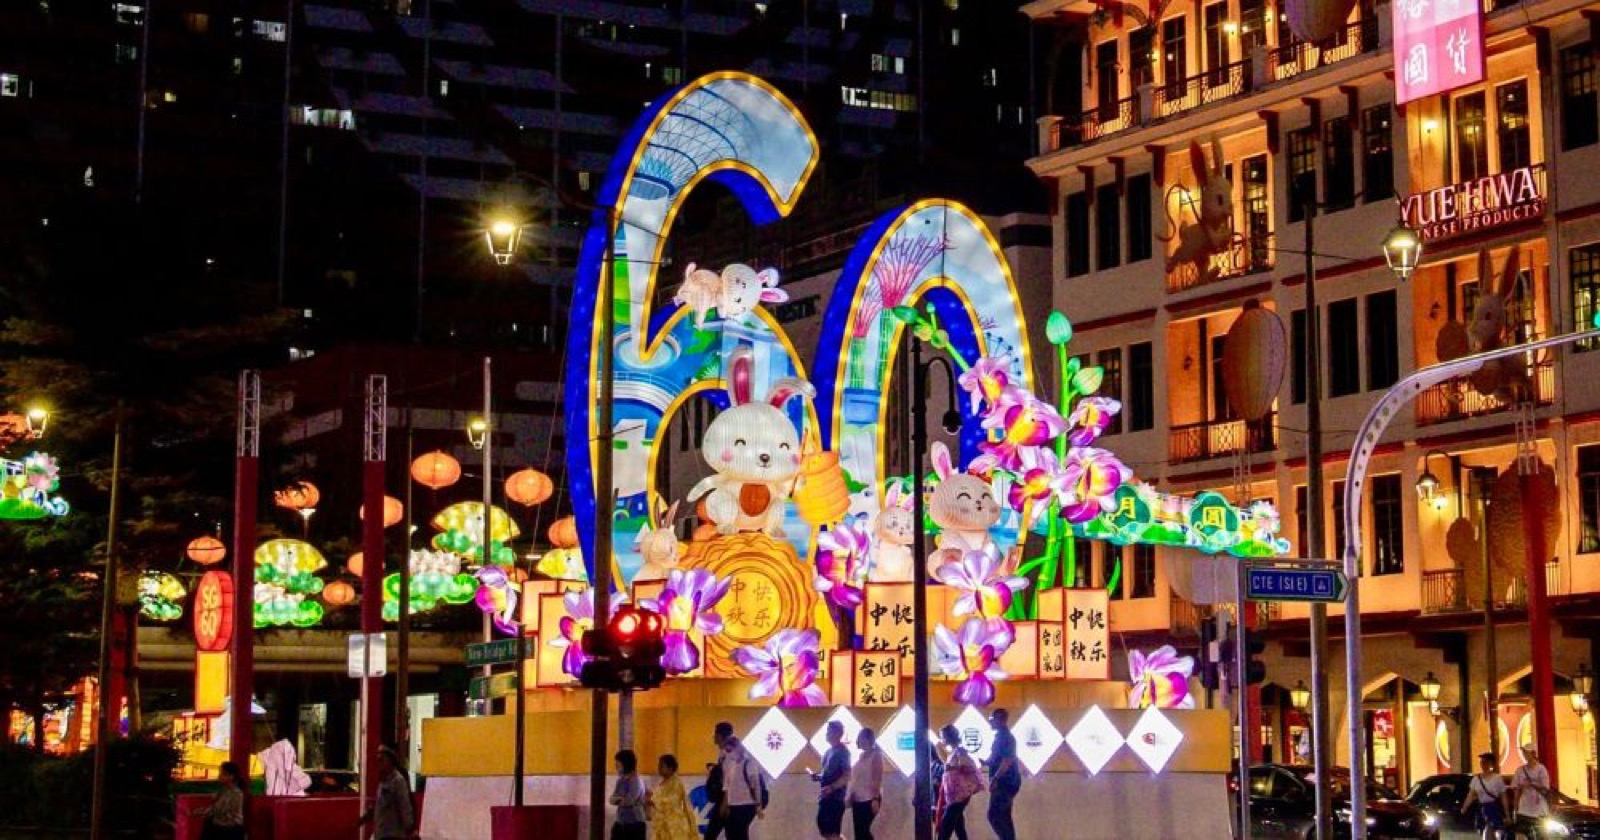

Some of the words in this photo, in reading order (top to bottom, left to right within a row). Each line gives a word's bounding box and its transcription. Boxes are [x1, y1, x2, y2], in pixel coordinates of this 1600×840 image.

[1401, 185, 1456, 228] YUE
[1464, 167, 1539, 214] HWA
[1463, 203, 1540, 231] PRODUCTS
[1117, 497, 1136, 519] 月
[1252, 575, 1273, 590] CTE
[202, 585, 219, 608] SG
[201, 610, 217, 636] 60
